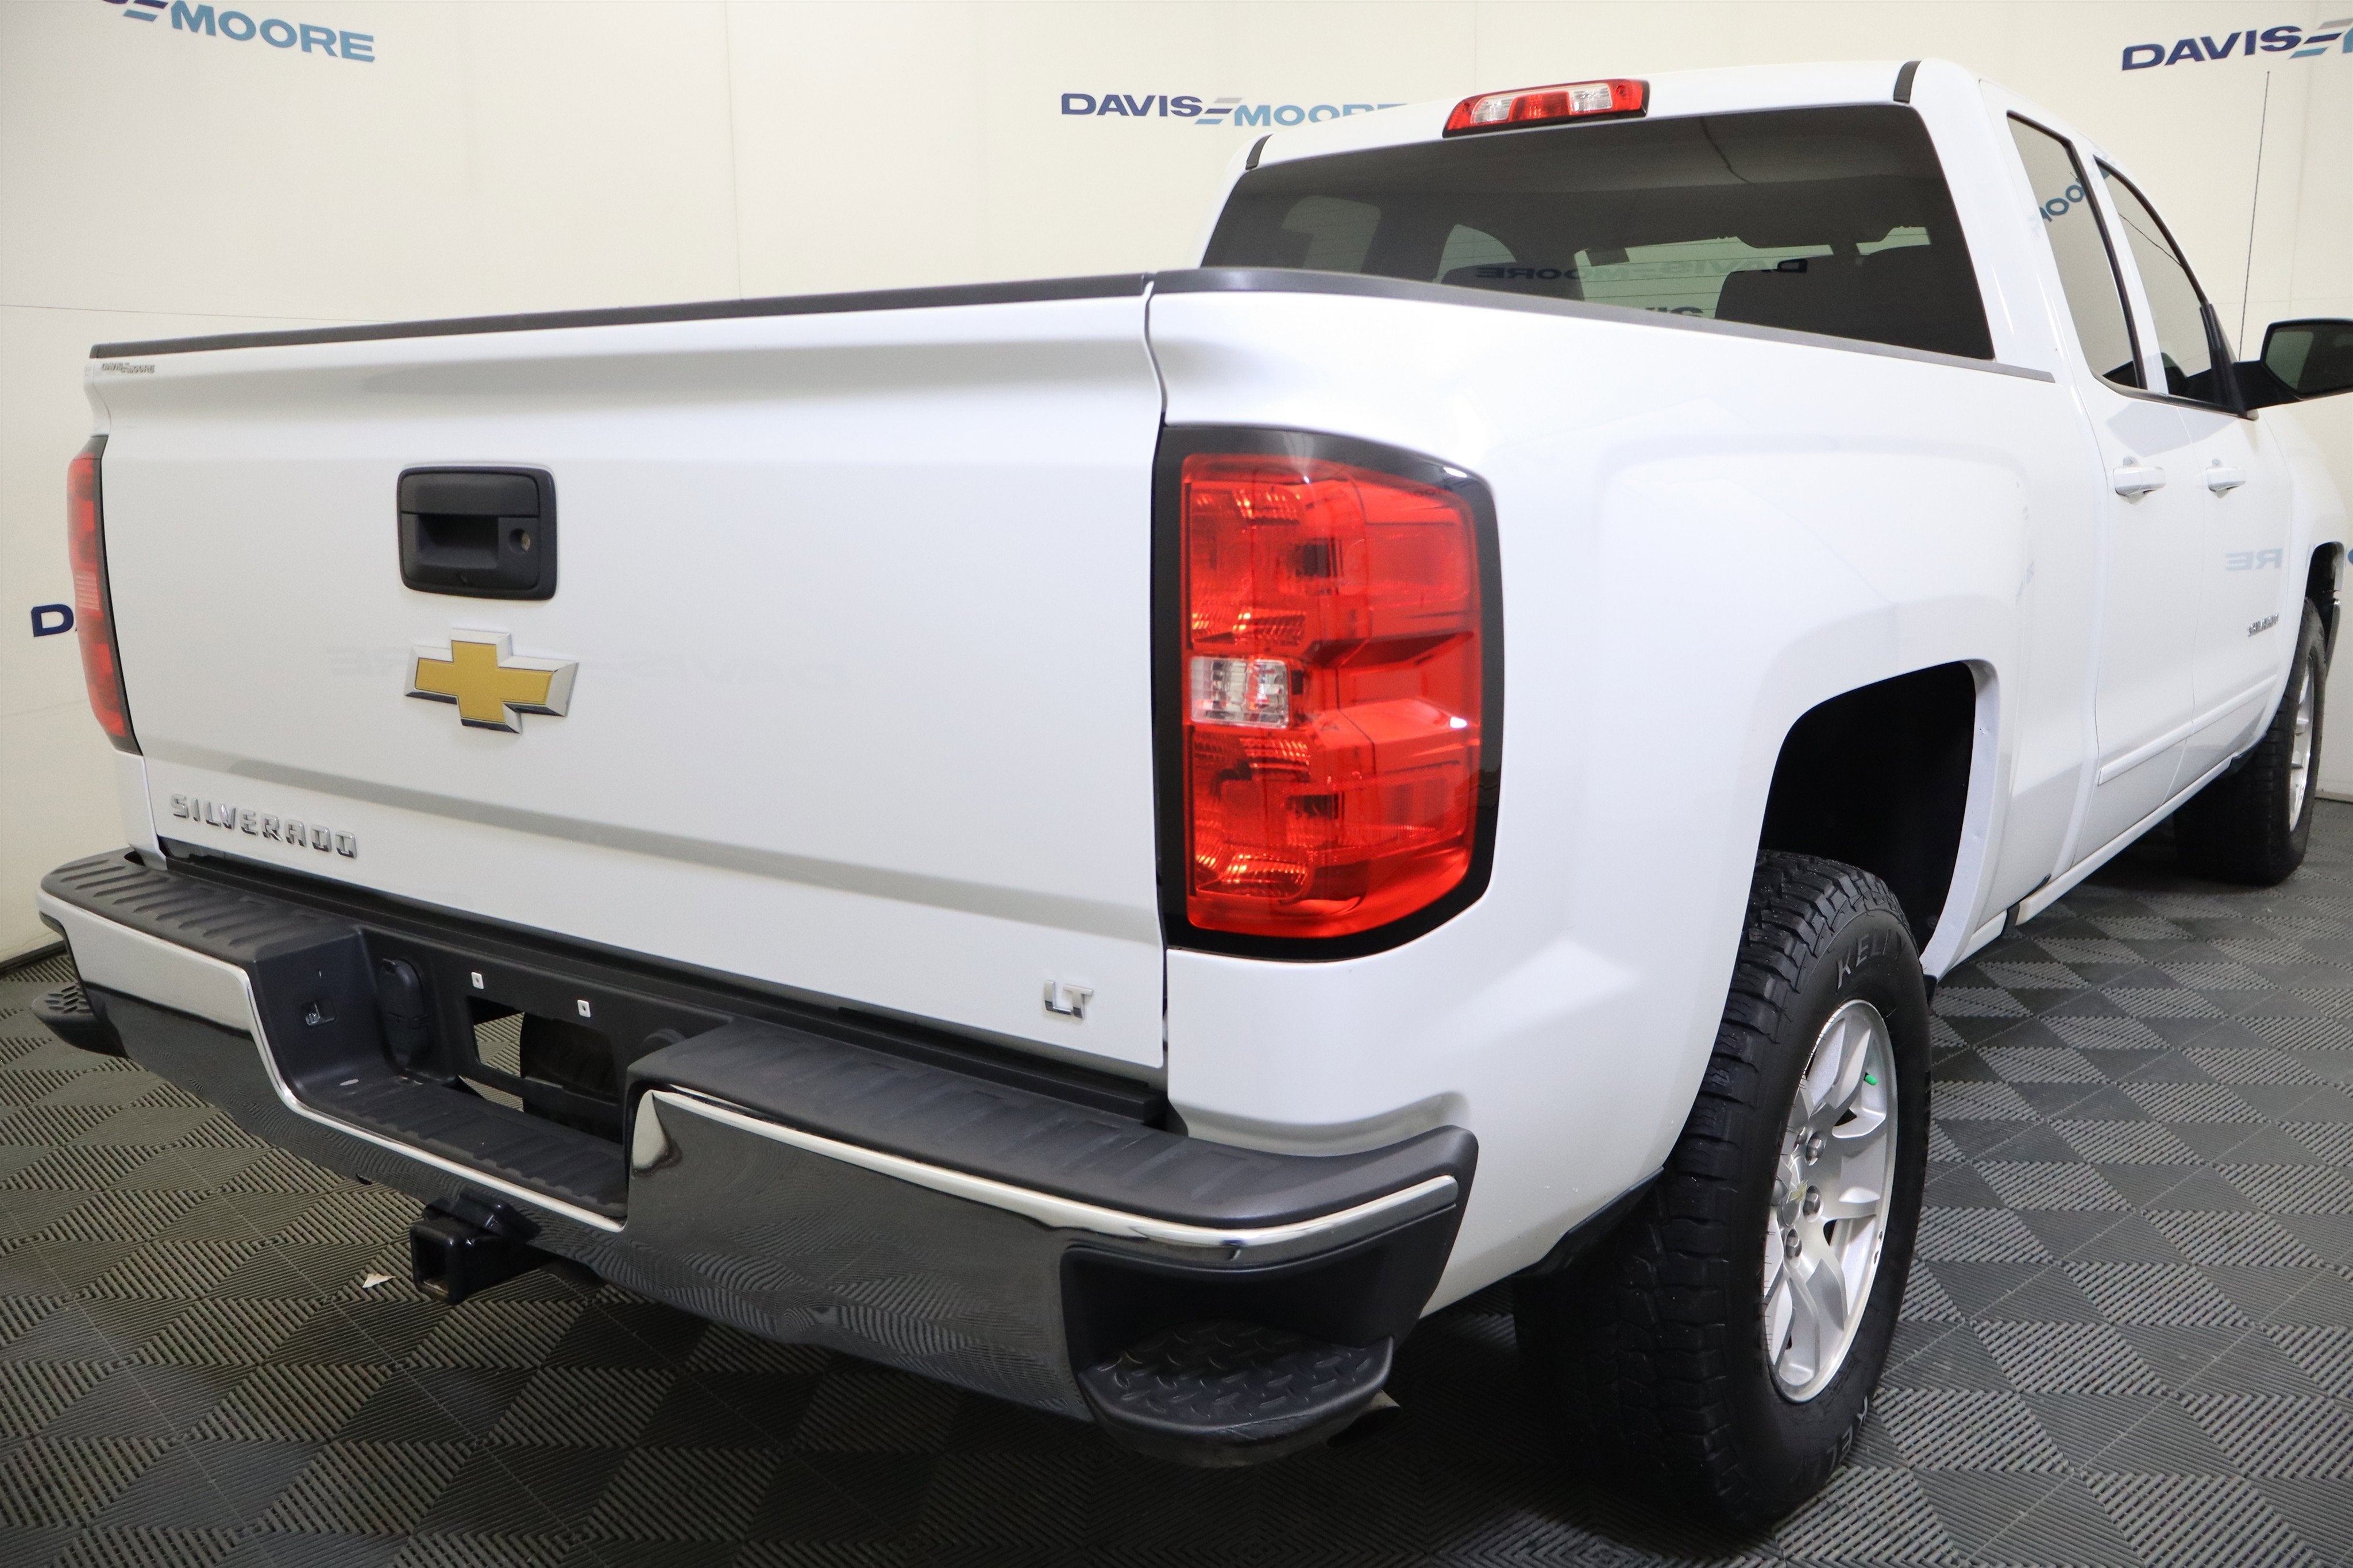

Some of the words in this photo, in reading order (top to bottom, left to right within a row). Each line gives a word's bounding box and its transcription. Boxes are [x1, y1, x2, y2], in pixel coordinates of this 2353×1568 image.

[171, 0, 376, 62] MOORE
[2121, 26, 2302, 71] DAVIS
[1061, 93, 1203, 117] DAVIS
[1234, 103, 1407, 126] MOO
[171, 793, 357, 859] SILVERADO
[1043, 980, 1093, 1018] LT
